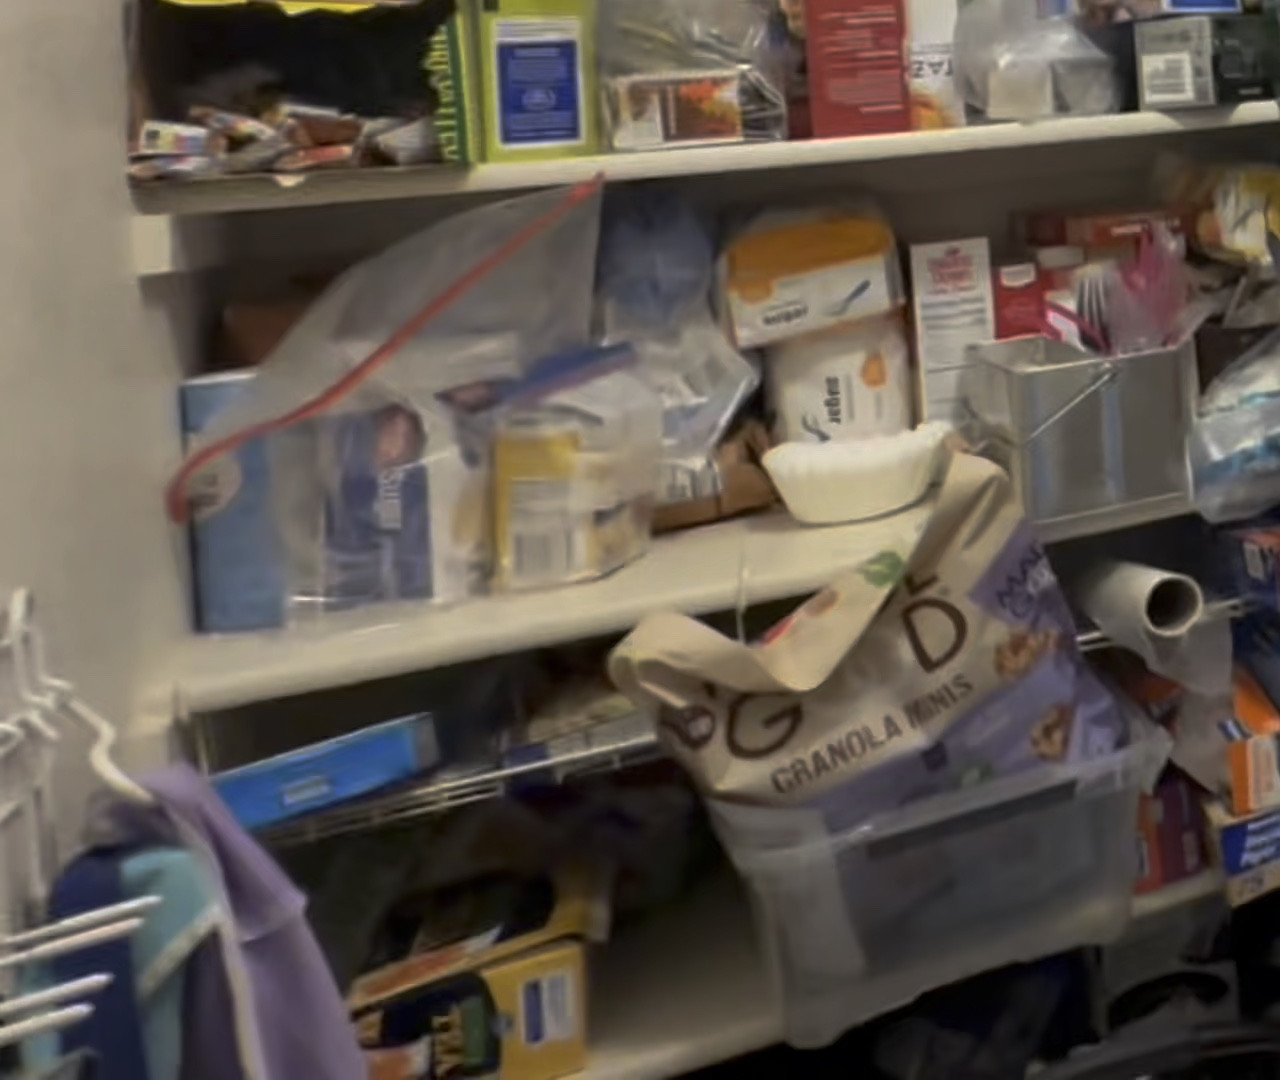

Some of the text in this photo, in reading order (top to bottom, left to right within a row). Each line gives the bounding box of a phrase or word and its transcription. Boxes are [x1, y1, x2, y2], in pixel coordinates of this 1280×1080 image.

[911, 54, 955, 80] TAZ
[769, 672, 976, 797] GRANOLA MINIS
